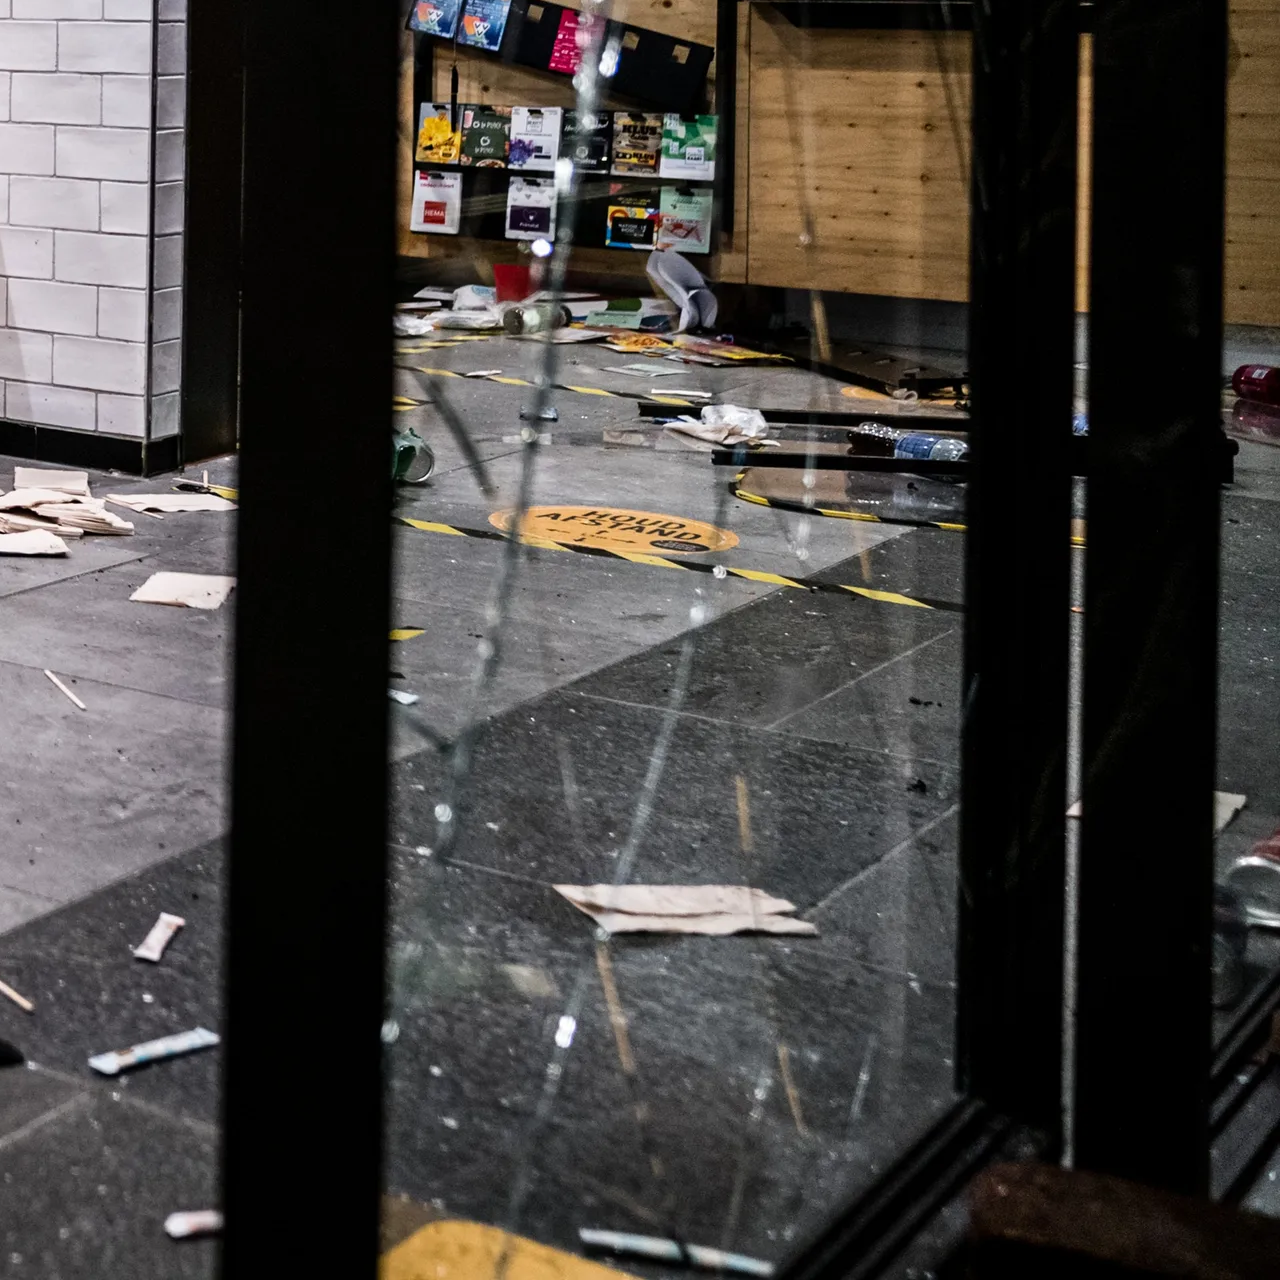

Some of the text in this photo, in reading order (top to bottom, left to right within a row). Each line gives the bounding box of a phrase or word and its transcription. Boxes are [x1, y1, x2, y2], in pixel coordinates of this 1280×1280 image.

[424, 209, 444, 217] HEMA
[536, 513, 702, 541] AFSTAND
[583, 510, 686, 530] HOUD
